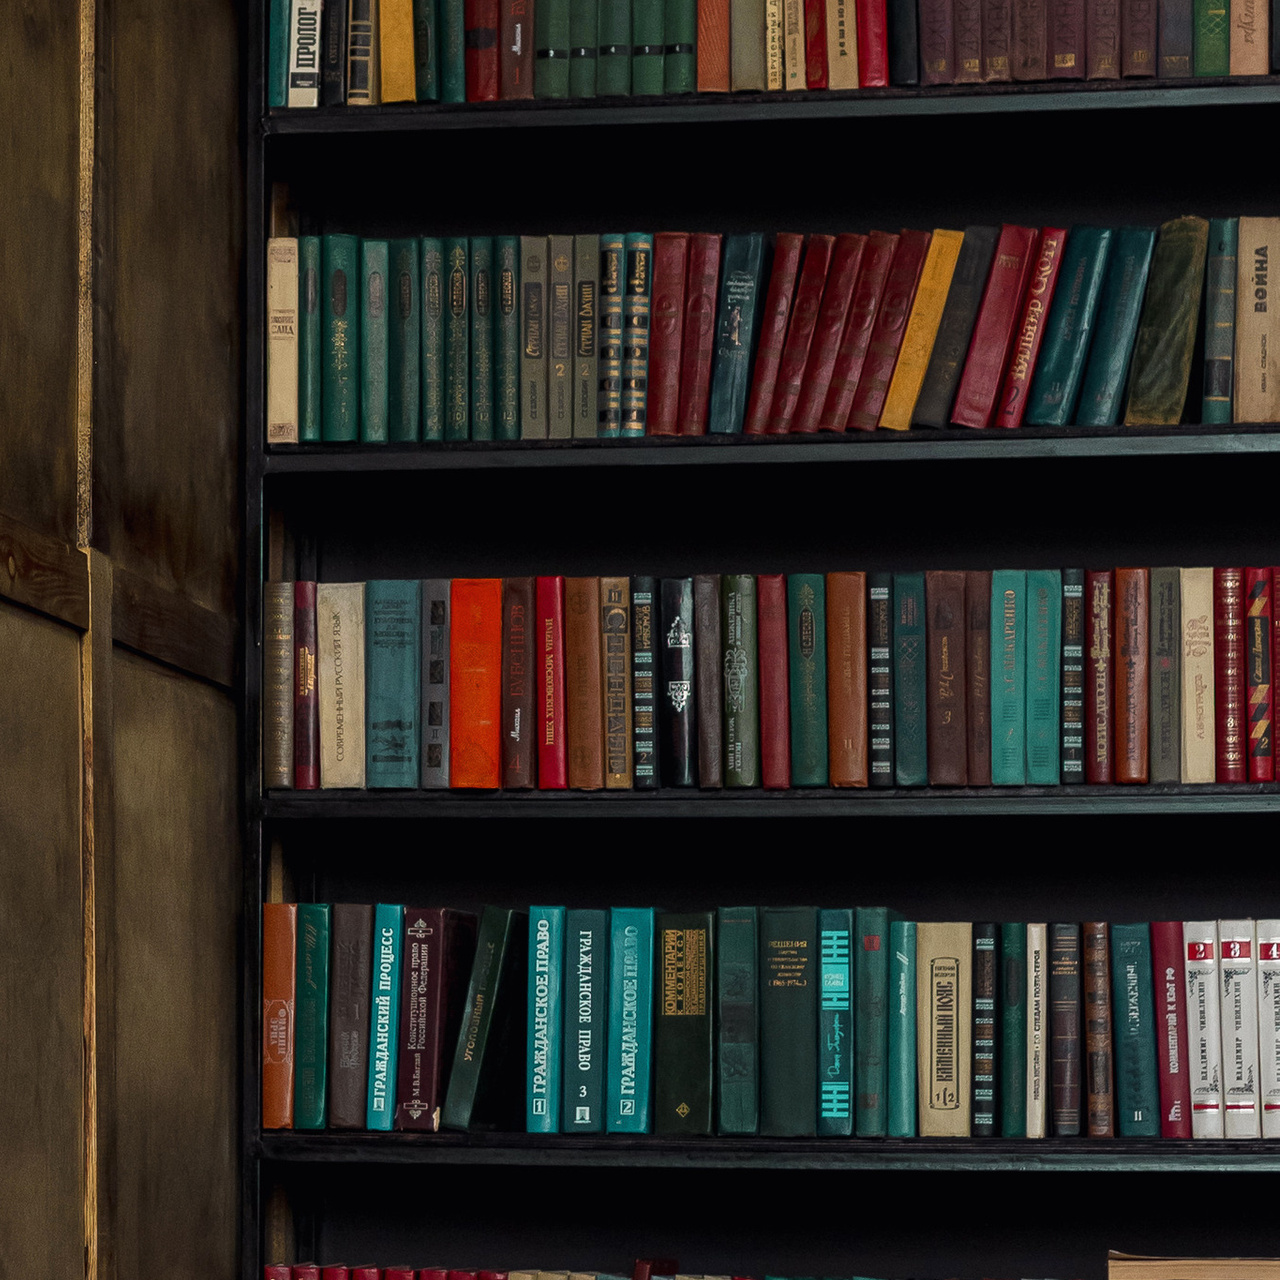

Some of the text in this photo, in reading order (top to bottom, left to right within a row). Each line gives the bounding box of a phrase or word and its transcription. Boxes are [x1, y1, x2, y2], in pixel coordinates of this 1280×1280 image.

[296, 7, 317, 68] ПРОЛОГ
[770, 11, 778, 84] зарубежный
[1030, 237, 1058, 297] СКОТТ
[1251, 245, 1268, 313] ВОЙНА
[579, 319, 594, 355] СТЕПАН
[642, 605, 651, 649] НАБОКОВ
[331, 610, 345, 762] СОВРЕМЕННЫЙ РУССКИЙ ЯЗЫК
[545, 618, 555, 745] ИМЕНА МОСКОВСКИХ УЛИЦ
[1096, 719, 1107, 763] МОРИС
[536, 919, 550, 973] ПРАВО
[662, 929, 676, 1015] КОММЕНТАРИЙ
[676, 929, 684, 1000] КОДЕКСУ
[1033, 950, 1041, 998] ПОЭТА-ГЕРОЯ
[1165, 966, 1176, 981] РФ
[374, 927, 395, 1096] ГРАЖДАНСКИЙ ПРОЦЕСС
[407, 942, 422, 1096] М.В.Баглай Конституционное право
[417, 943, 429, 1050] Российской Федерации
[463, 994, 485, 1062] УГОЛОВНЫЙ
[576, 930, 592, 1097] ГРАЖДАНСКОЕ ПРАВО 3
[934, 981, 954, 1082] КАМЕННЫЙ ПОЯС
[1198, 981, 1208, 1081] ВЛАДИМИР ЧИВИЛИХИН
[1234, 981, 1243, 1081] ВЛАДИМИР ЧИВИЛИХИН
[533, 974, 549, 1094] ГРАЖДАНСКОЕ
[1167, 1012, 1179, 1074] КОММЕНТАРИЙ
